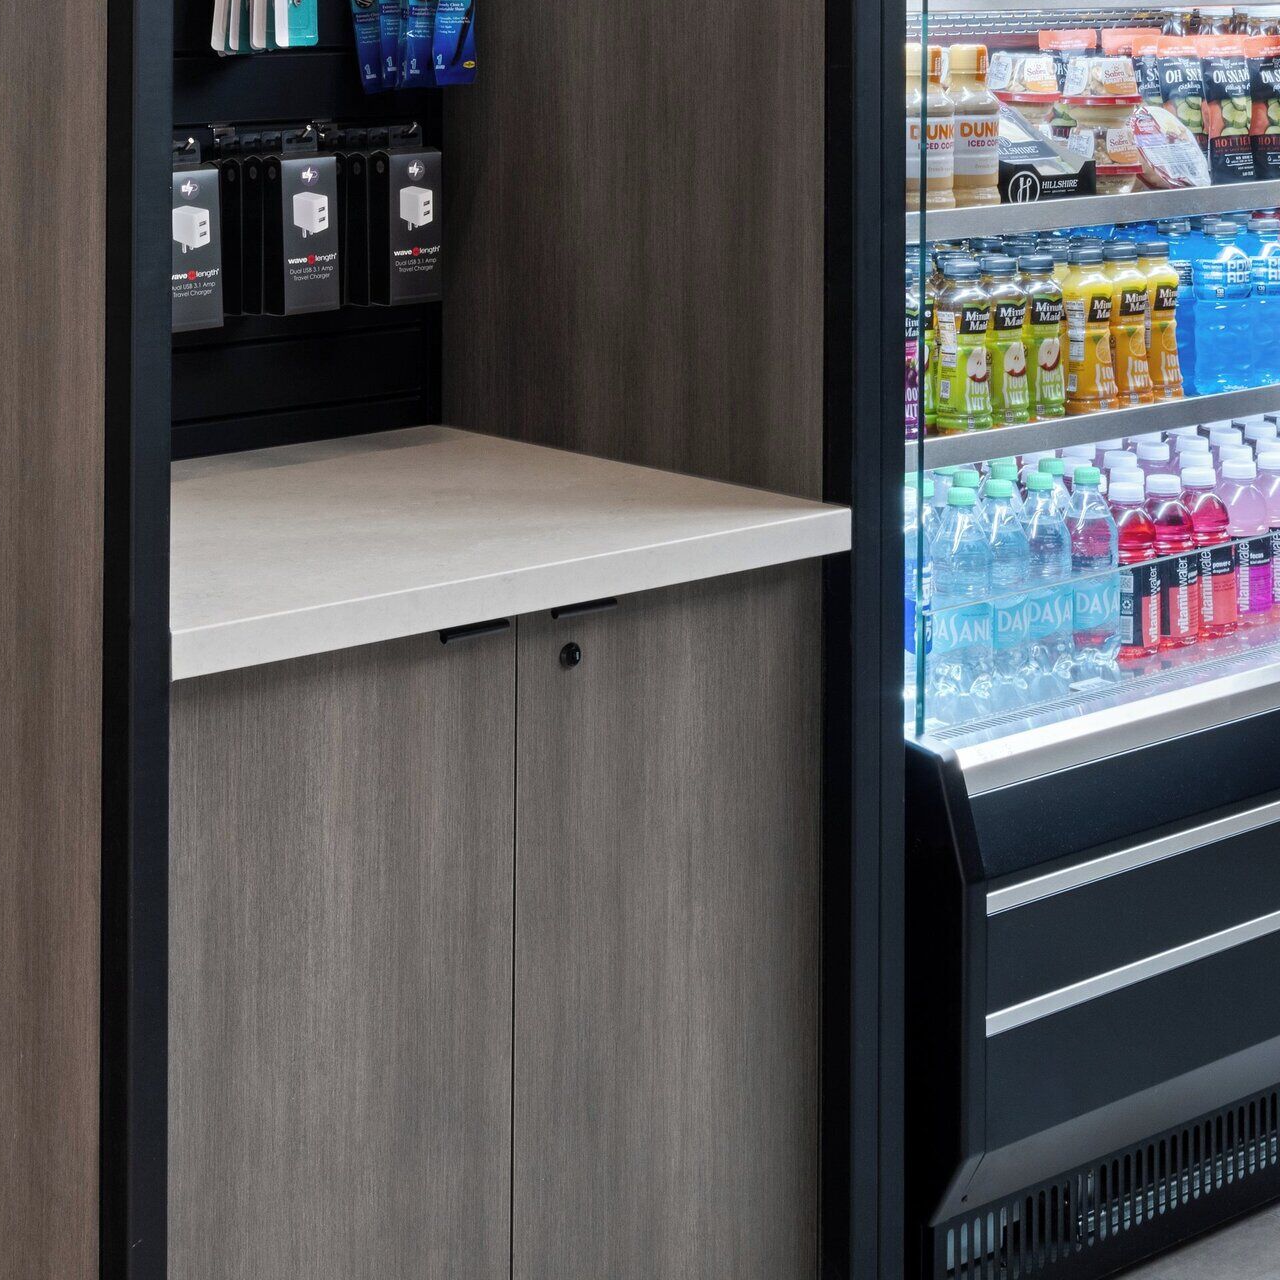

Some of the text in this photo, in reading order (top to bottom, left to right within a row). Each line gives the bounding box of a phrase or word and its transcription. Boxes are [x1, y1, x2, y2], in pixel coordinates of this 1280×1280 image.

[1104, 70, 1124, 79] Sabra
[1165, 70, 1183, 84] OH
[967, 139, 986, 148] ICED
[1109, 138, 1128, 147] Sabra
[1041, 179, 1078, 189] HILLSHIRE
[312, 266, 321, 274] 3.1
[321, 265, 334, 273] Amp
[293, 272, 330, 281] Travel Charger
[1227, 272, 1250, 283] ADE
[193, 281, 202, 289] 3.1
[203, 281, 216, 289] Amp
[173, 288, 212, 298] Travel Charger
[1176, 557, 1189, 634] vitaminwater
[1148, 565, 1157, 643] vitaminwater
